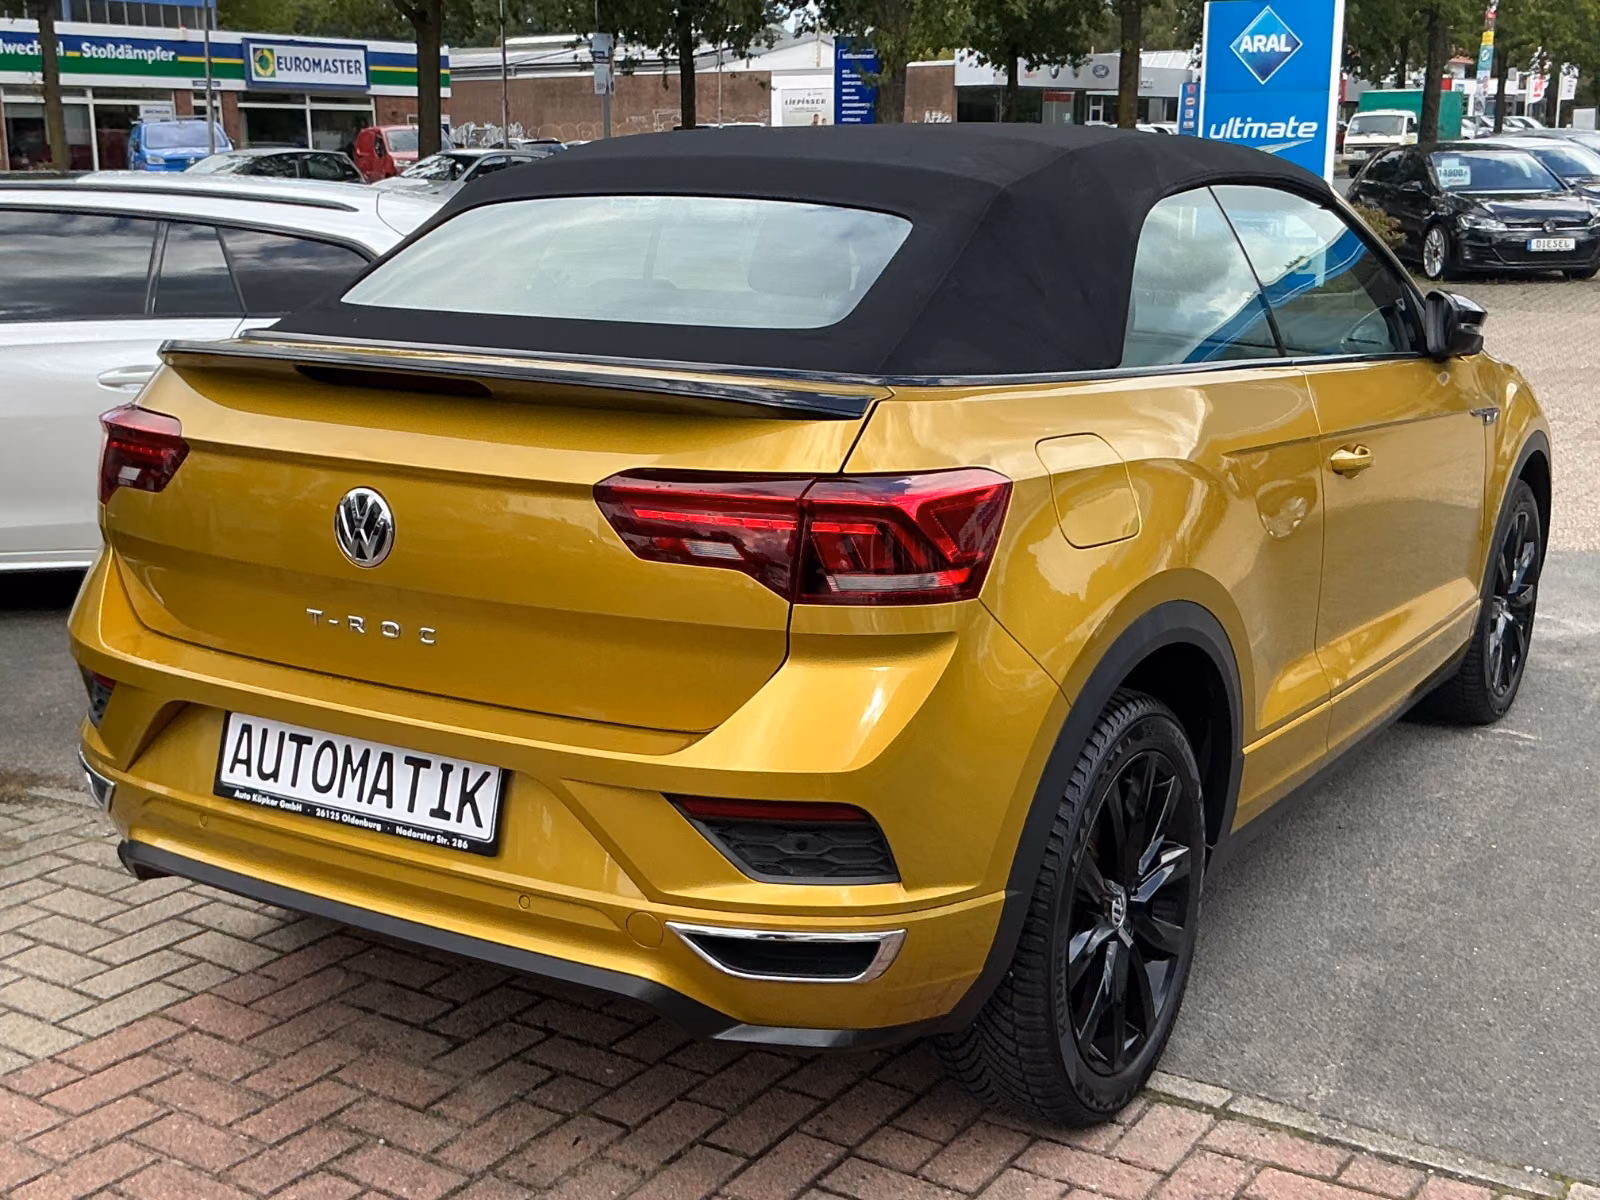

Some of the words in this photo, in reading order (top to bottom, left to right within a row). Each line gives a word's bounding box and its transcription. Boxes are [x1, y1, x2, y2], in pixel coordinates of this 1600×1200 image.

[81, 42, 176, 64] Stoßdämpfer
[1239, 33, 1291, 53] ARAL
[276, 55, 363, 75] EUROMASTER
[1209, 115, 1318, 139] ultimate
[1536, 239, 1570, 249] DIESEL
[306, 608, 437, 645] T-ROC
[229, 723, 491, 828] AUTOMATIK
[234, 789, 251, 801] Auto
[279, 799, 302, 812] GmbH
[315, 808, 340, 821] 26125
[451, 838, 469, 850] 286
